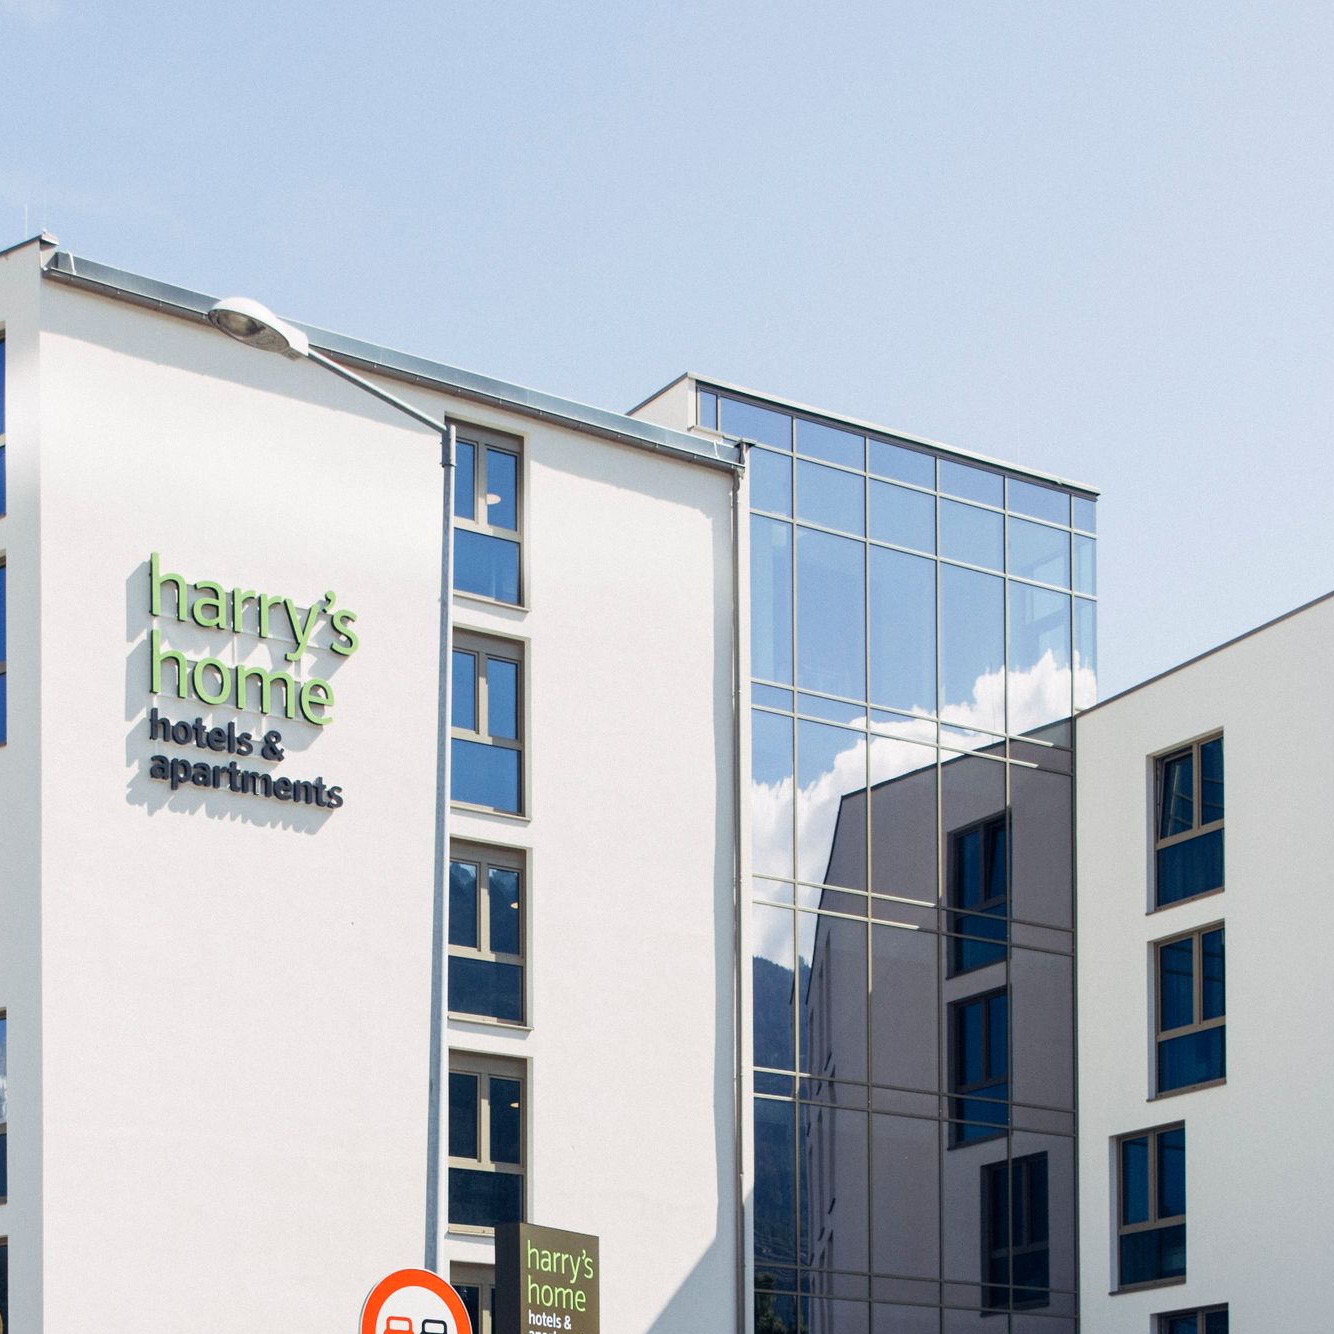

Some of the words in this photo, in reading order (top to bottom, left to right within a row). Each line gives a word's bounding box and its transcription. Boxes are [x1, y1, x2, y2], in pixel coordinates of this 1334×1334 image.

[149, 552, 360, 662] harry's
[149, 629, 335, 725] home
[149, 708, 253, 756] hotels
[261, 730, 285, 762] &
[149, 754, 344, 809] apartments
[527, 1239, 594, 1284] harry's
[527, 1274, 586, 1312] home
[528, 1309, 561, 1329] hotels
[563, 1315, 572, 1330] &
